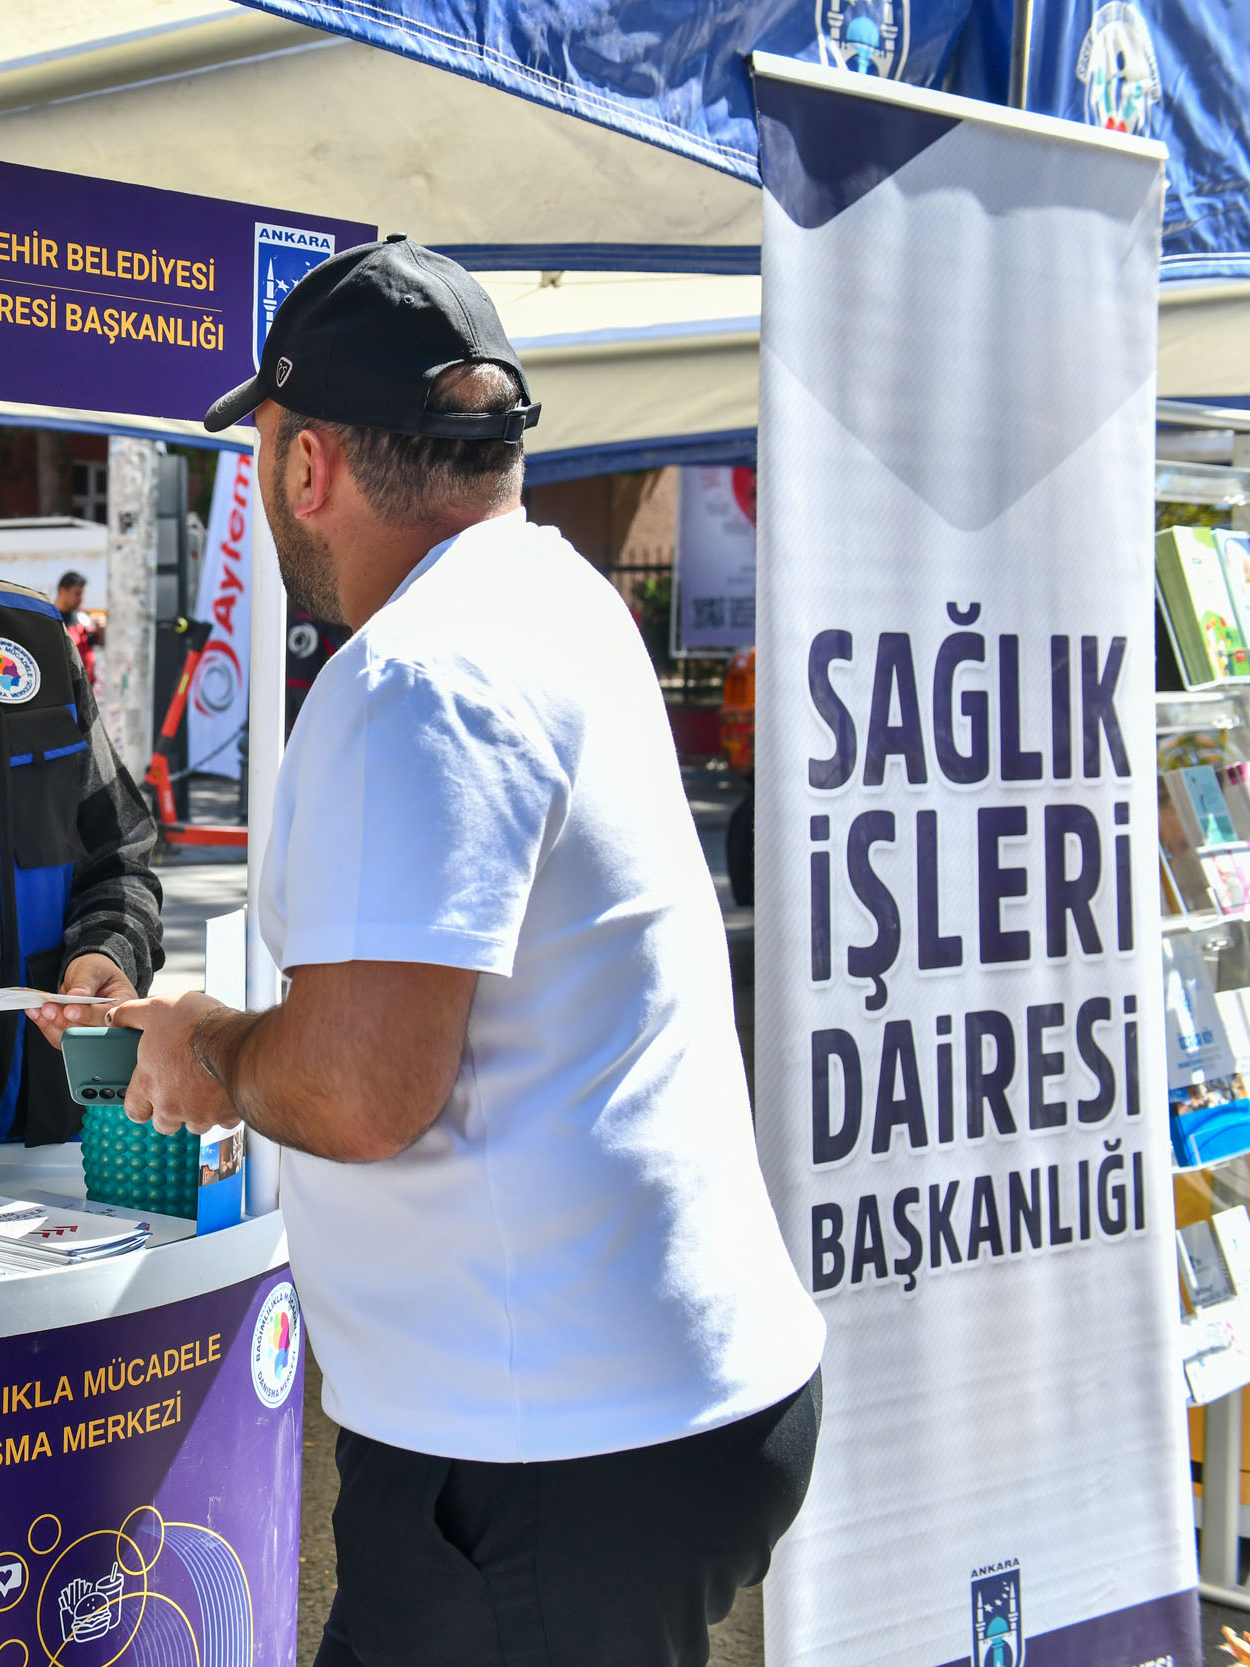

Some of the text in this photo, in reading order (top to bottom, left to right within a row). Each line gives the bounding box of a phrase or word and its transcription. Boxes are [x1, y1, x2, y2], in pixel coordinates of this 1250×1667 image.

[66, 242, 215, 292] BELEDİYESİ
[258, 228, 331, 250] ANKARA
[65, 302, 224, 351] BAŞKANLIĞI
[807, 601, 1132, 790] SAĞLIK
[809, 801, 1134, 1011] İŞLERİ
[811, 995, 1141, 1165] DAİRESİ
[811, 1138, 1146, 1293] BAŞKANLIĞI
[83, 1333, 222, 1398] MÜCADELE
[62, 1390, 182, 1454] MERKEZİ
[970, 1557, 1020, 1578] ANKARA
